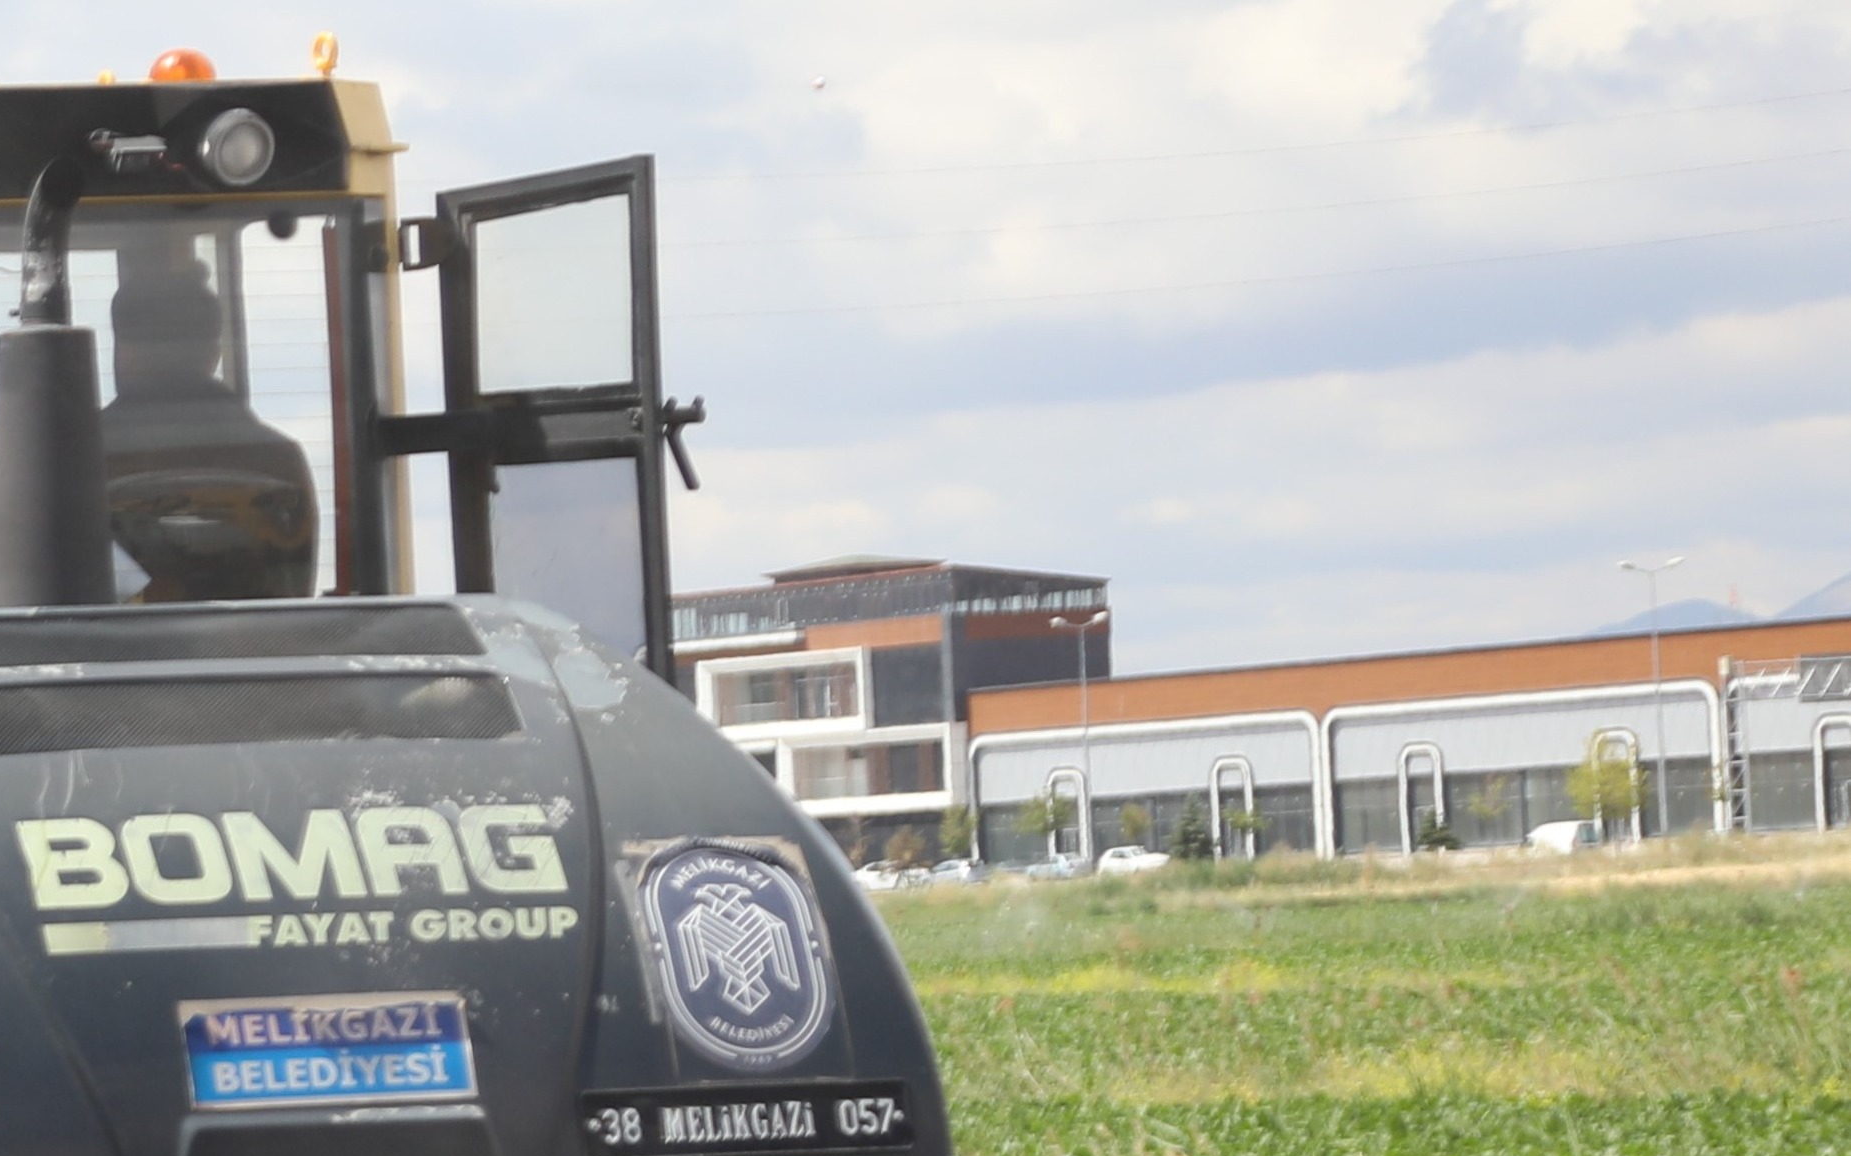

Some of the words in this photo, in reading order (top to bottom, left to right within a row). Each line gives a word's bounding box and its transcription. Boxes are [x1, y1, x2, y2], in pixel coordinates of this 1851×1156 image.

[15, 804, 570, 911] BOMAG
[253, 911, 396, 948] FAYAT
[409, 906, 580, 942] GROUP
[213, 1043, 450, 1094] BELEDİYESİ
[601, 1107, 644, 1146] 38
[837, 1096, 896, 1137] 057
